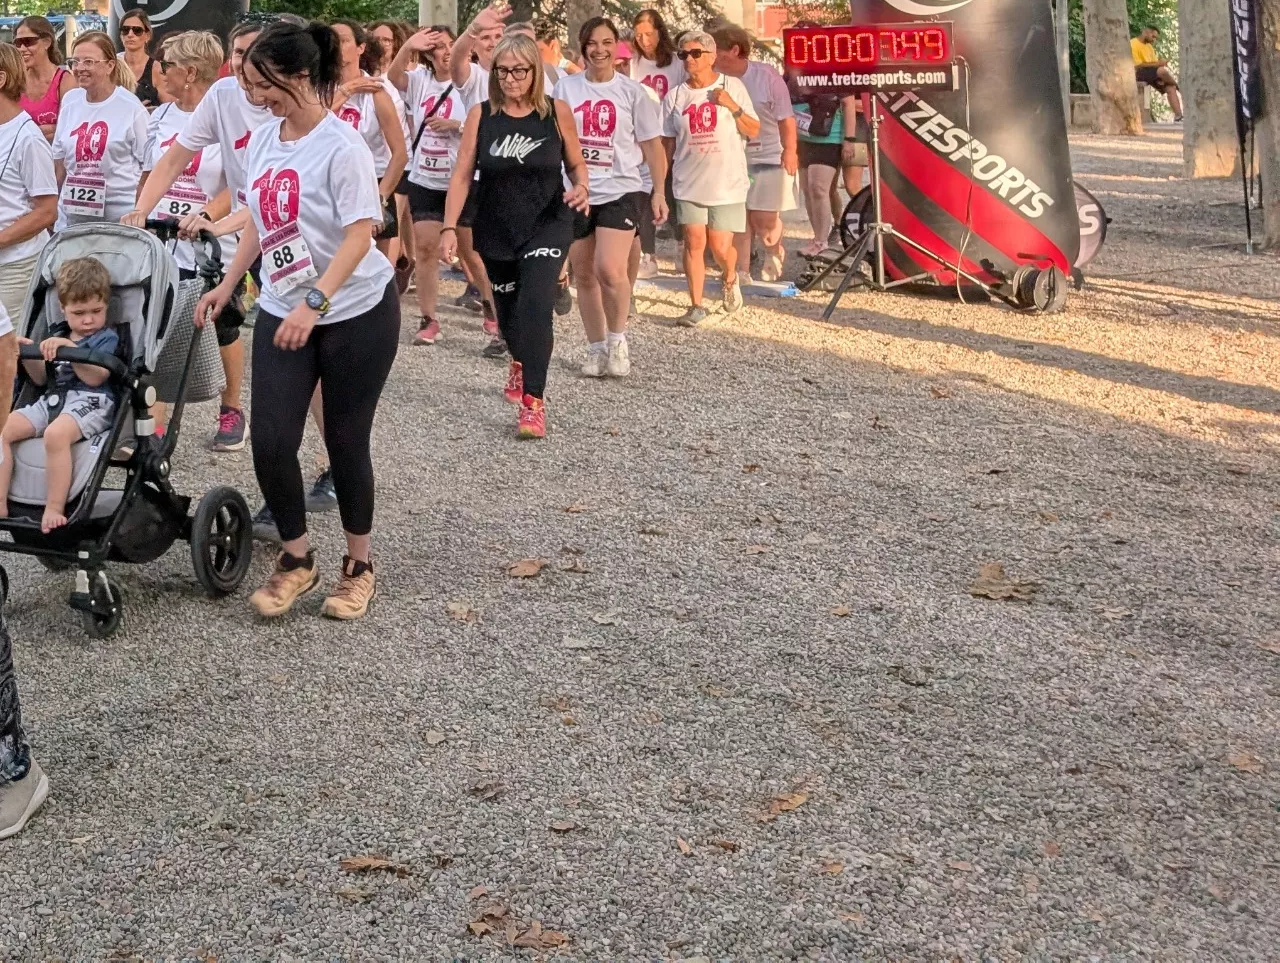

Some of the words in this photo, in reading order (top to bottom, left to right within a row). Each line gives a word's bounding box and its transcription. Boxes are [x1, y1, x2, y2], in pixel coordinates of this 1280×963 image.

[796, 70, 947, 87] www.tretzesports.com
[573, 99, 617, 137] 10
[70, 121, 108, 162] 10
[425, 157, 438, 167] 67
[581, 148, 600, 161] 62
[70, 187, 97, 202] 122
[251, 167, 300, 231] 10
[169, 201, 192, 216] 82
[273, 245, 295, 269] 88
